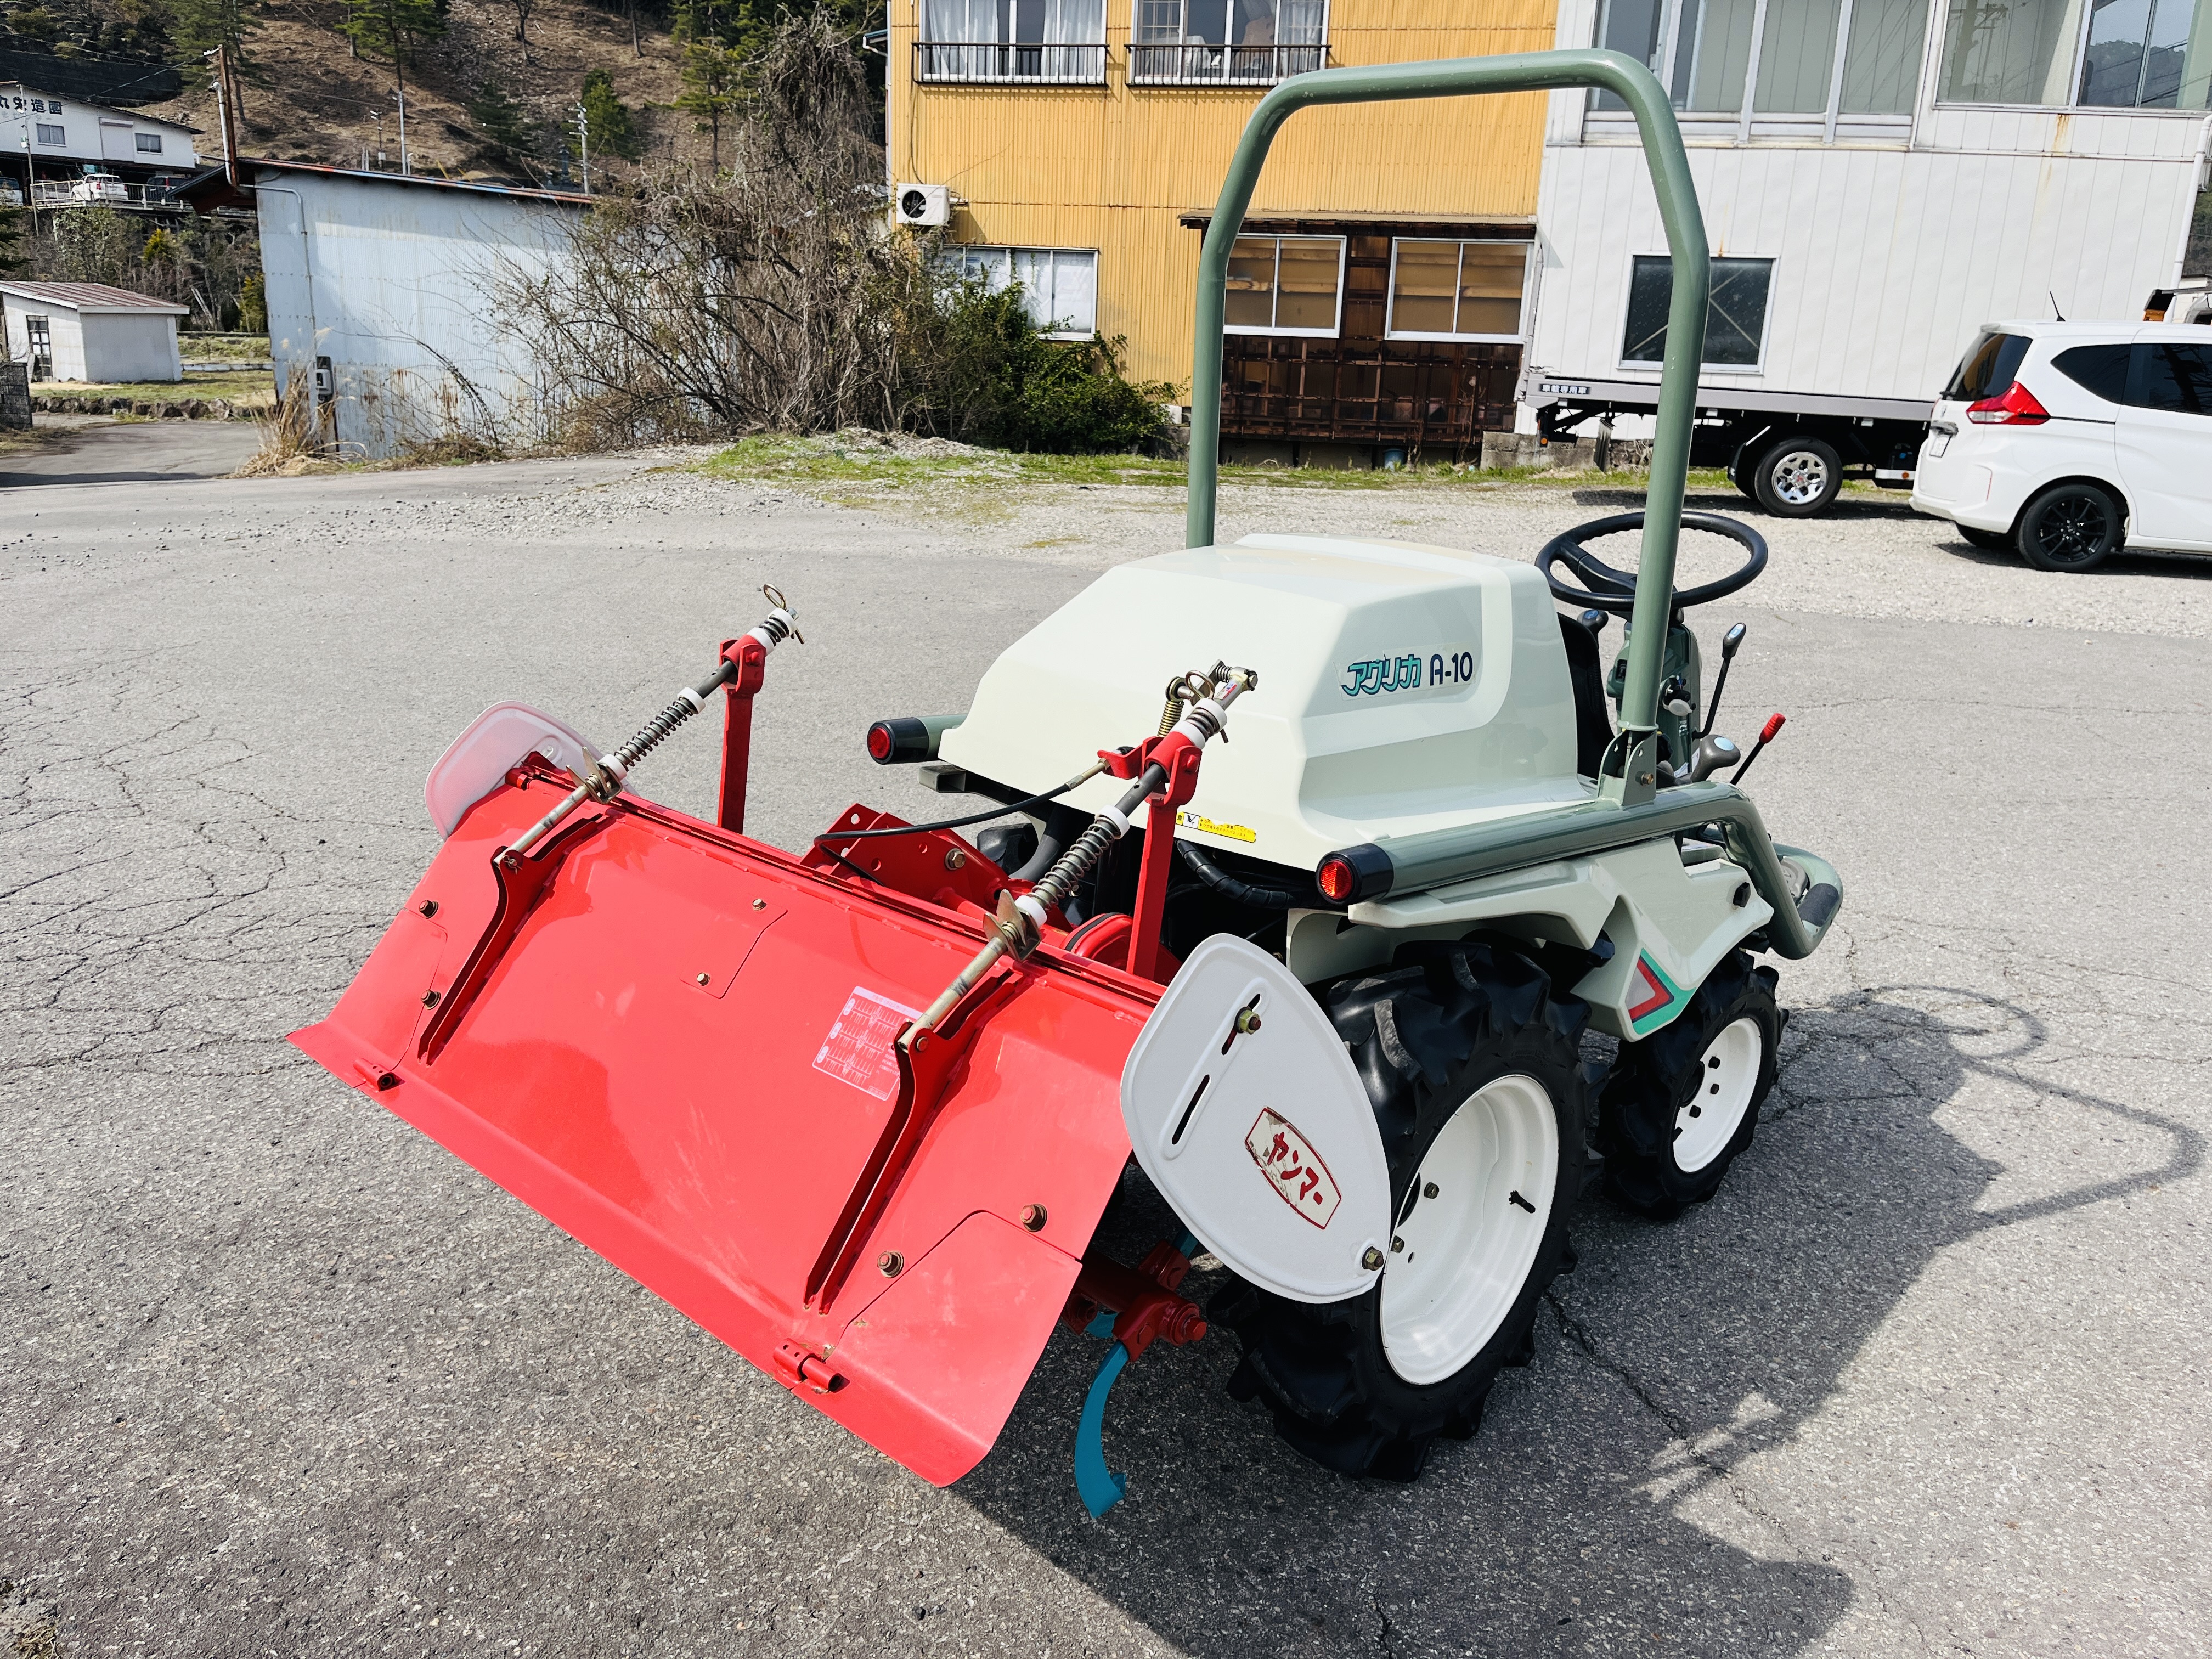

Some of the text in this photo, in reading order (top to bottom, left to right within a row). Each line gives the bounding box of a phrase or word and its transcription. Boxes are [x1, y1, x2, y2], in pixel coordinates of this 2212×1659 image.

[1430, 651, 1474, 686] A-10
[1267, 1132, 1323, 1205] ヤンマー
